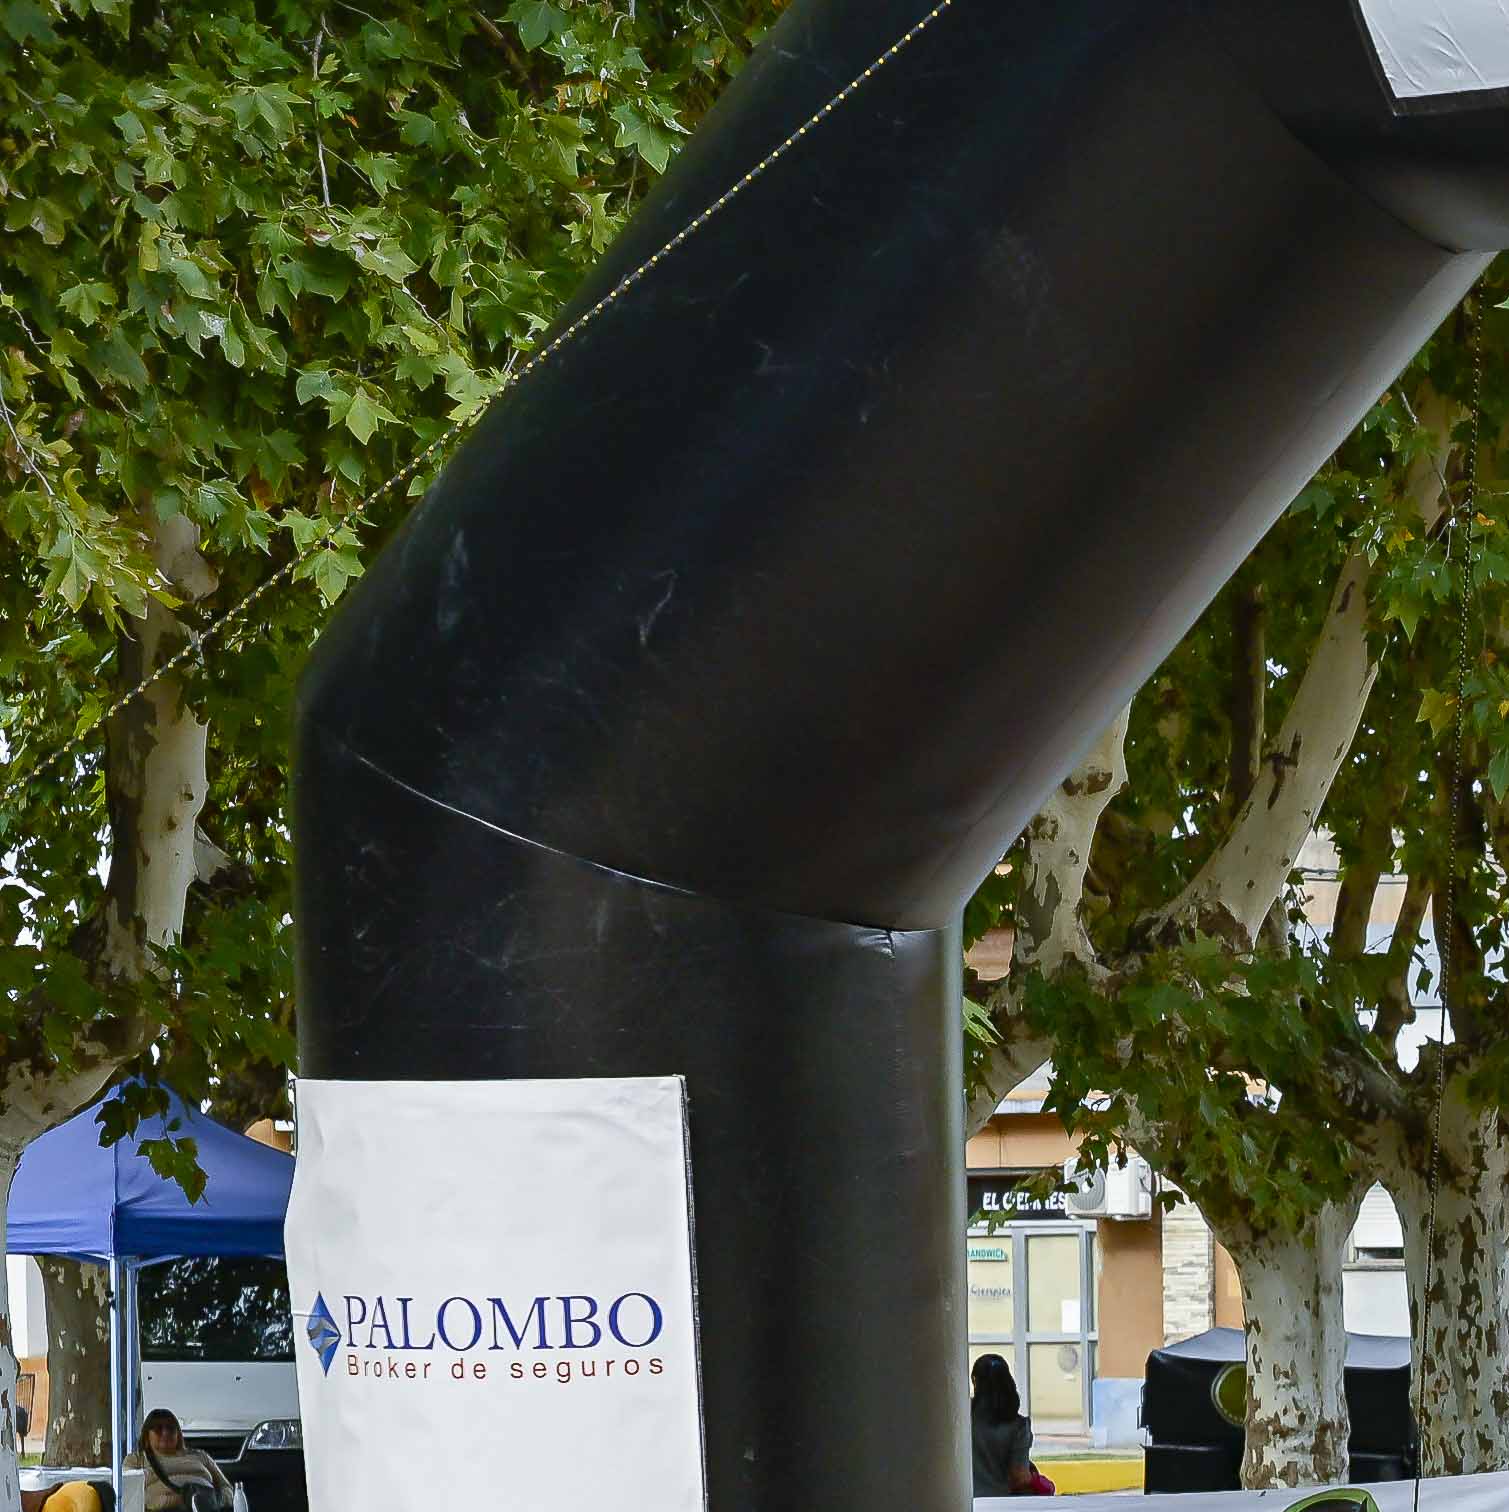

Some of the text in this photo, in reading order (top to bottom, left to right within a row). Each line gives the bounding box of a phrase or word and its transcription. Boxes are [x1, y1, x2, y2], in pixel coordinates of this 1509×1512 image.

[982, 1192, 1000, 1210] EL
[343, 1292, 663, 1351] PALOMBO
[347, 1354, 664, 1384] Broker de seguros
